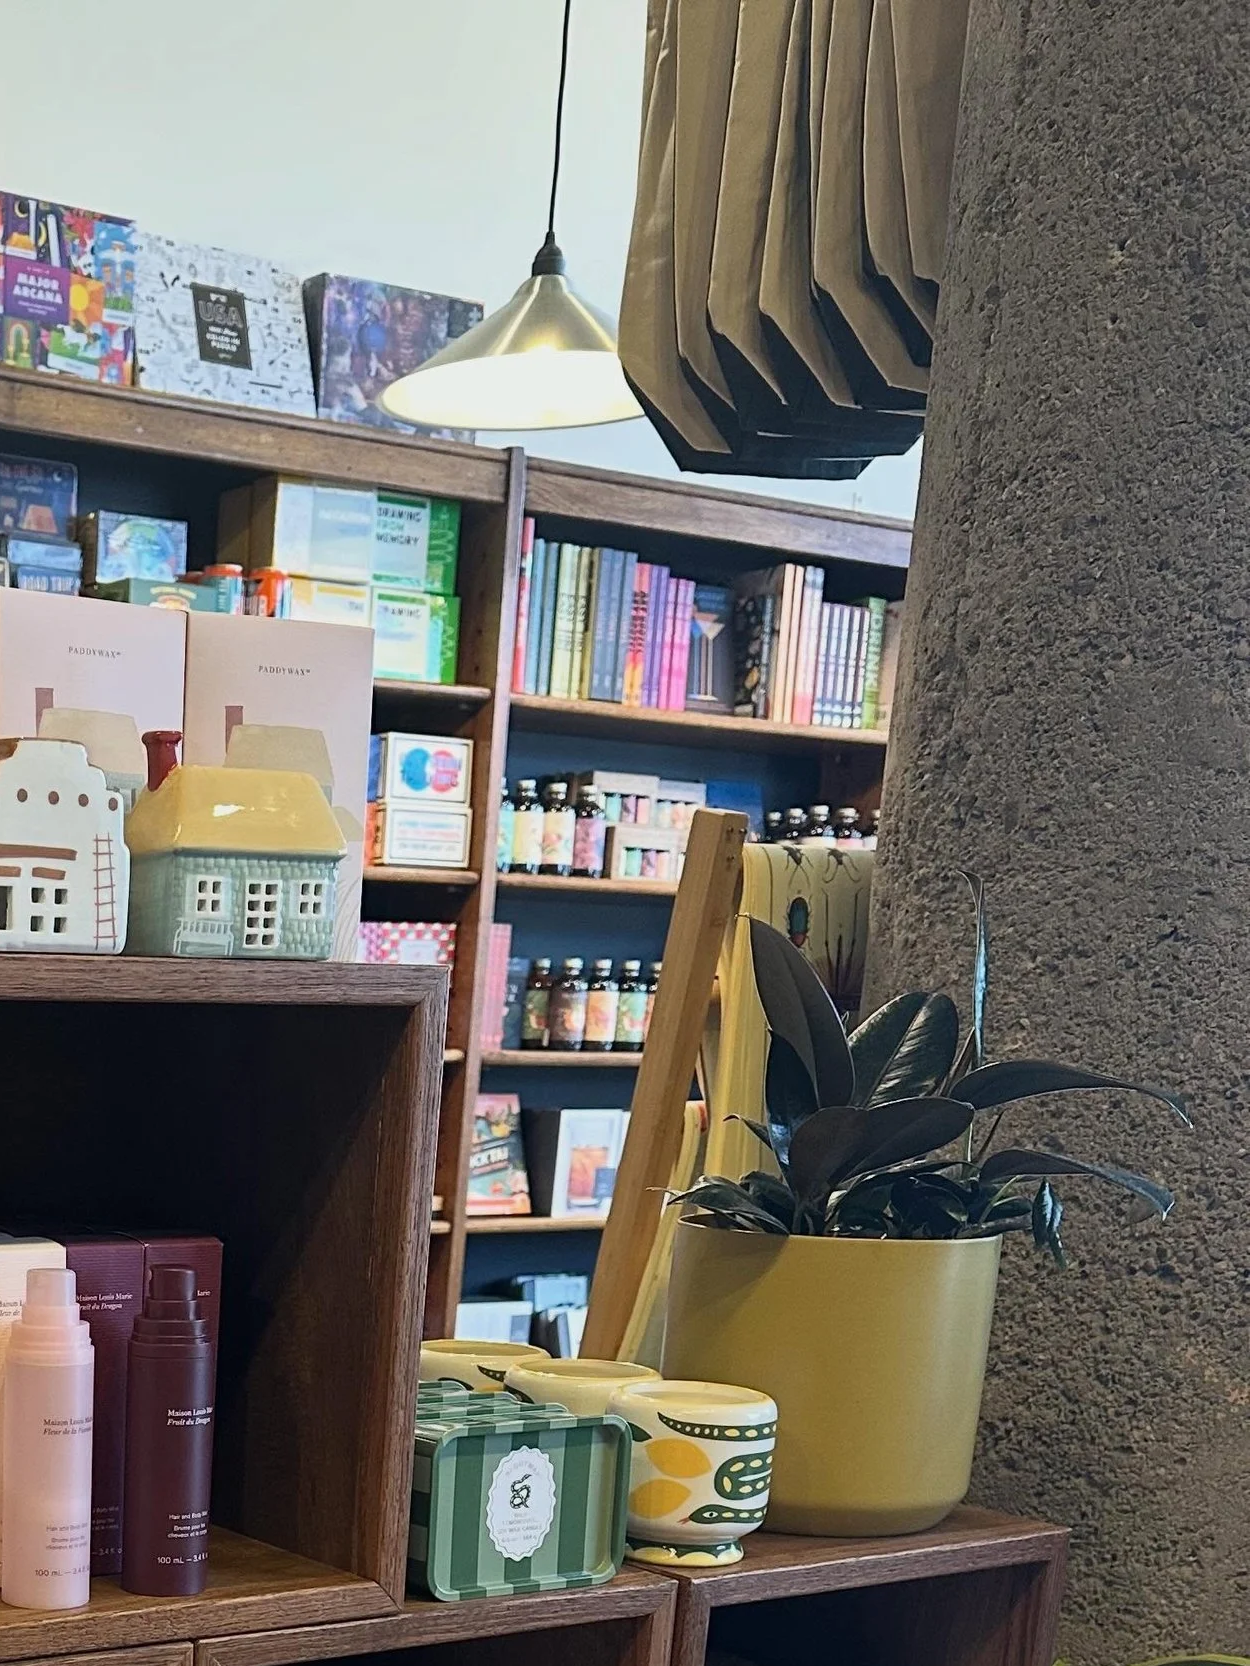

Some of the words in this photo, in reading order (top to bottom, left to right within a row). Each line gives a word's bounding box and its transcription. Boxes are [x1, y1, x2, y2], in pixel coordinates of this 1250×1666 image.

[197, 300, 243, 328] USA
[167, 1409, 192, 1417] Maison
[157, 1556, 171, 1564] 100
[35, 1569, 49, 1577] 100
